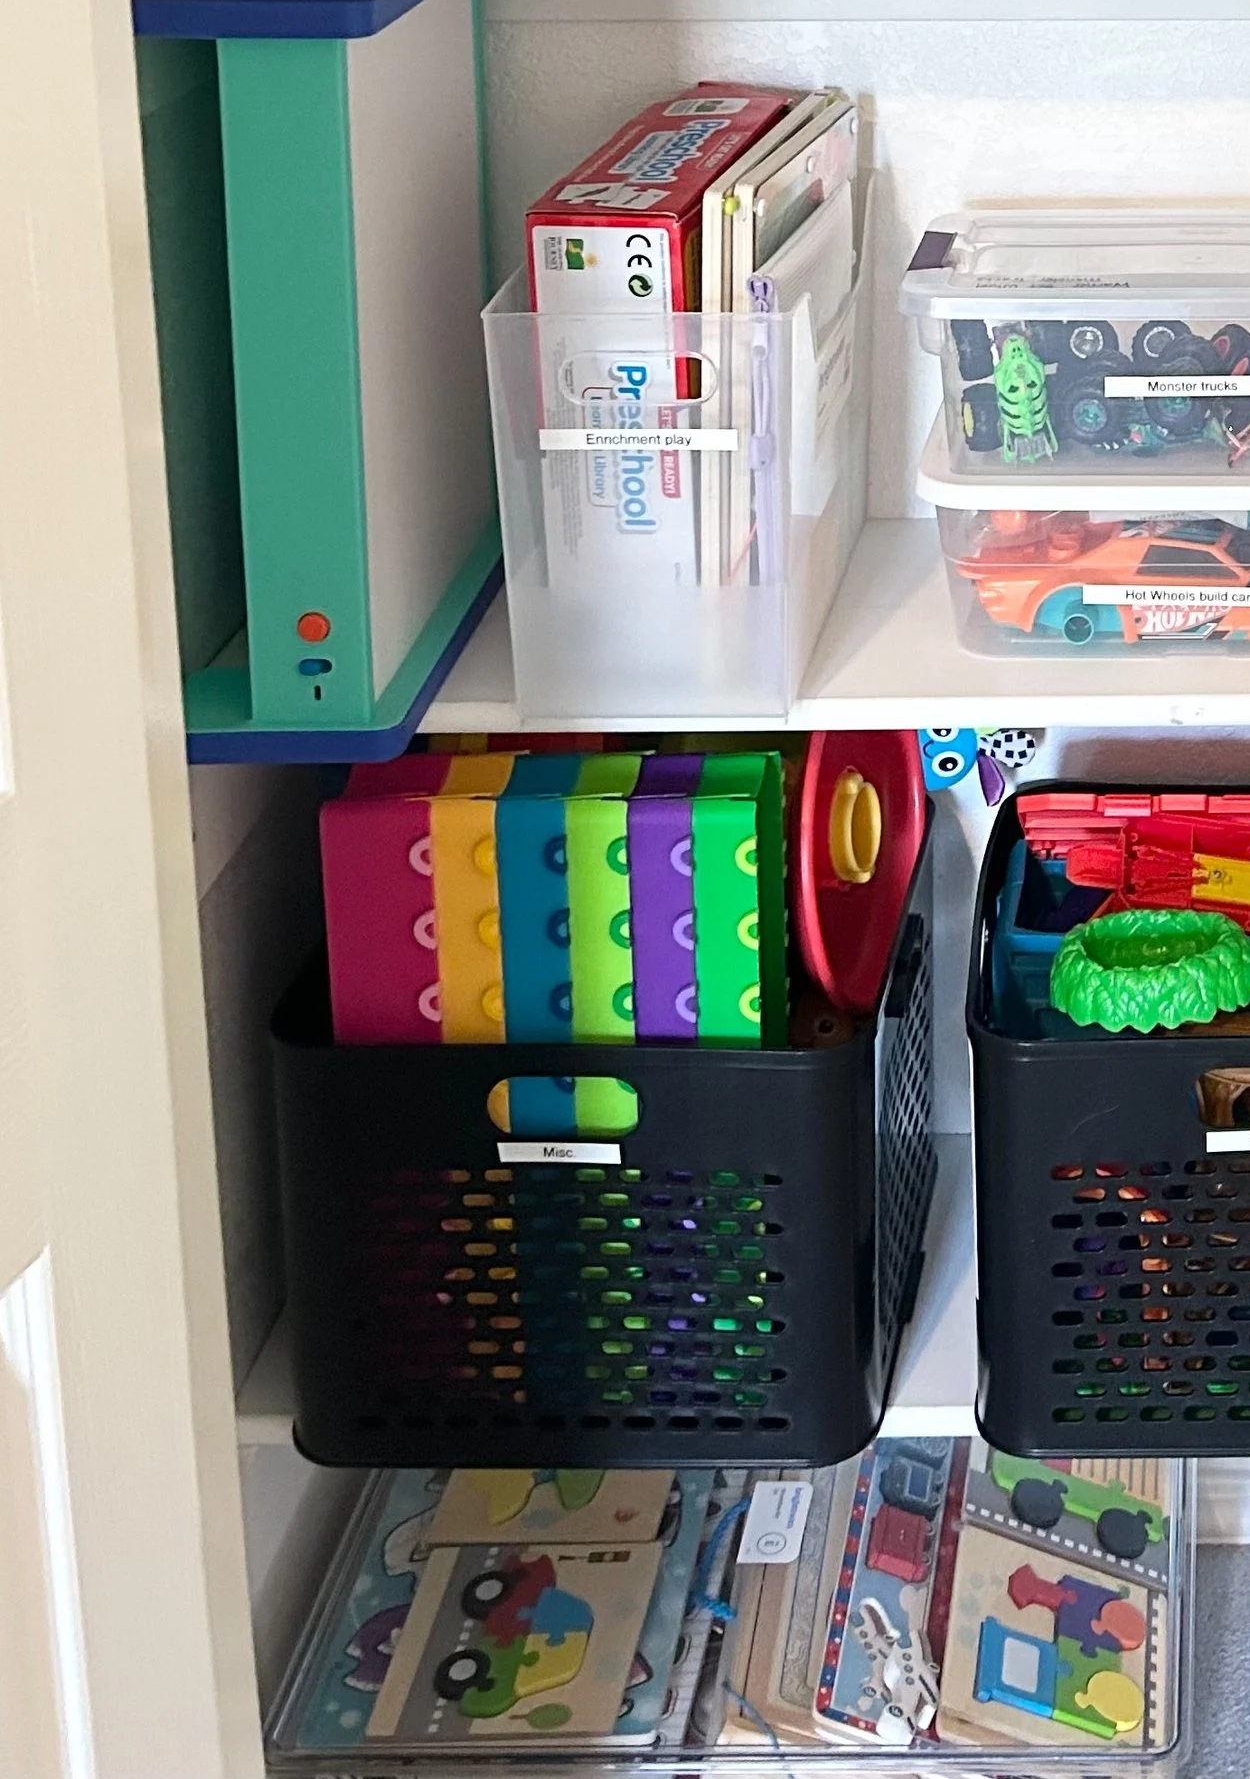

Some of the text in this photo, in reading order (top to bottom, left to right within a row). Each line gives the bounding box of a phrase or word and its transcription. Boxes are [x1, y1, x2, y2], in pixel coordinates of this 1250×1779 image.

[633, 120, 723, 182] Preschool
[1148, 380, 1238, 392] Monster trucks
[665, 433, 692, 446] play
[1125, 589, 1250, 603] Hot Wheels build car
